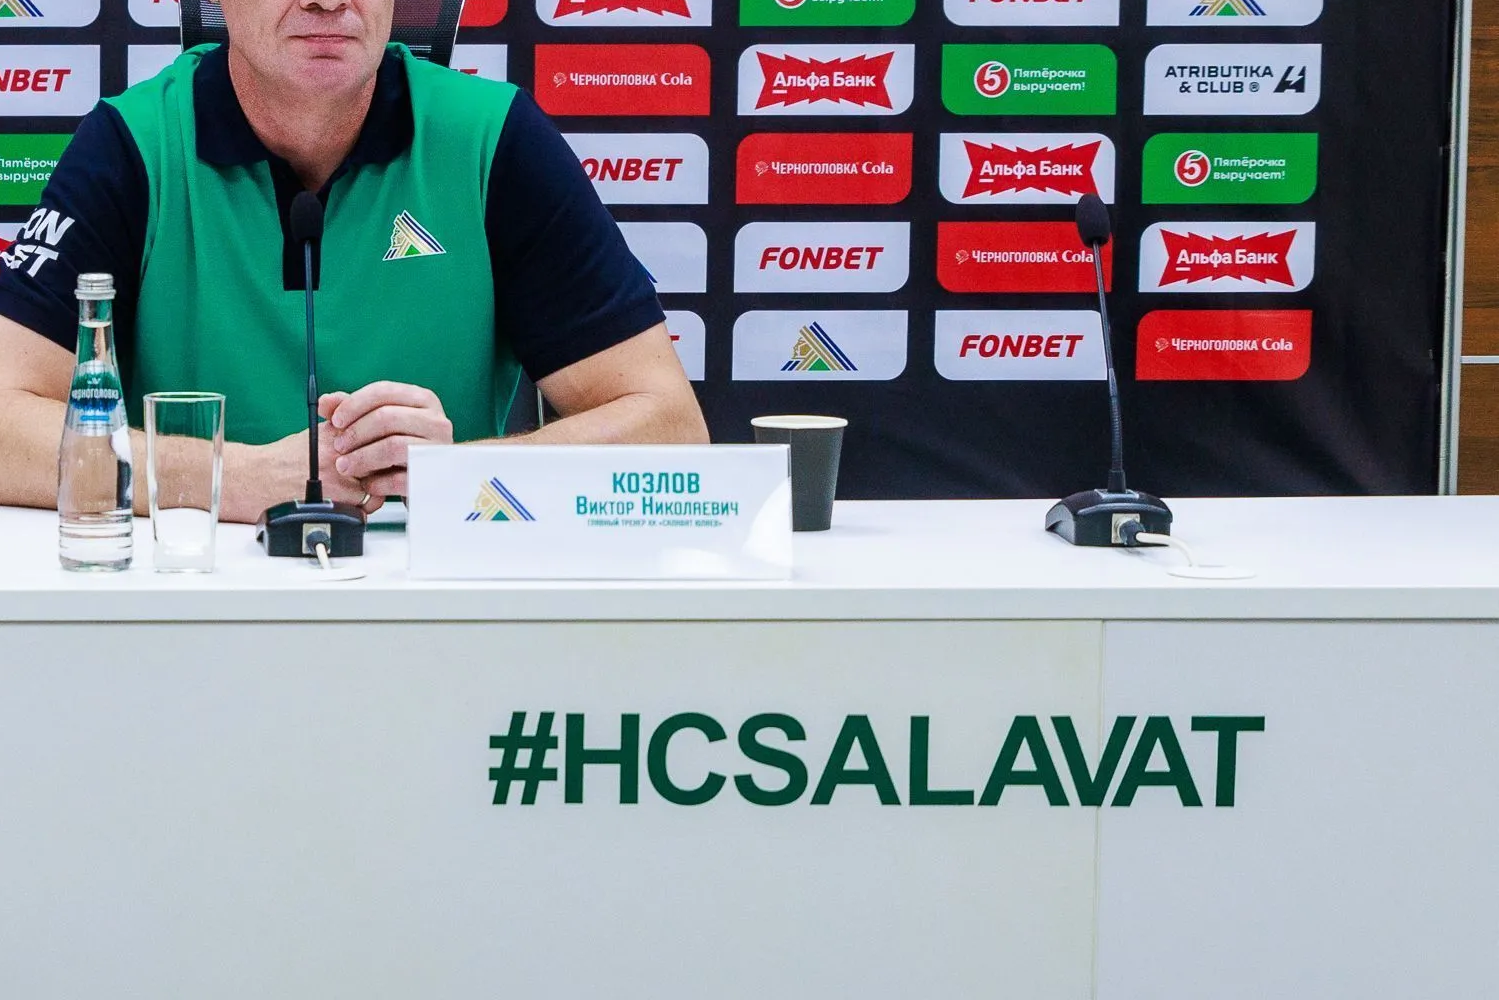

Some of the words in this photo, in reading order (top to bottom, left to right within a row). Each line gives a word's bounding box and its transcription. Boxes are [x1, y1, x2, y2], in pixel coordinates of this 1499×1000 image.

[773, 71, 829, 92] Альфа
[833, 71, 875, 87] Банк
[1013, 68, 1086, 80] Пятёрочка
[1166, 66, 1273, 77] ATRIBUTIKA
[1013, 81, 1085, 93] выручает!
[1198, 81, 1243, 93] CLUB
[580, 158, 683, 181] ONBET
[862, 162, 893, 174] Cola
[22, 208, 75, 246] ON
[760, 247, 884, 270] FONBET
[1177, 248, 1232, 269] Альфа
[1235, 248, 1278, 264] Банк
[960, 335, 1083, 357] FONBET
[1262, 338, 1293, 351] Cola
[612, 472, 700, 494] КОЗЛОВ
[488, 711, 1265, 807] #HCSALAVAT
